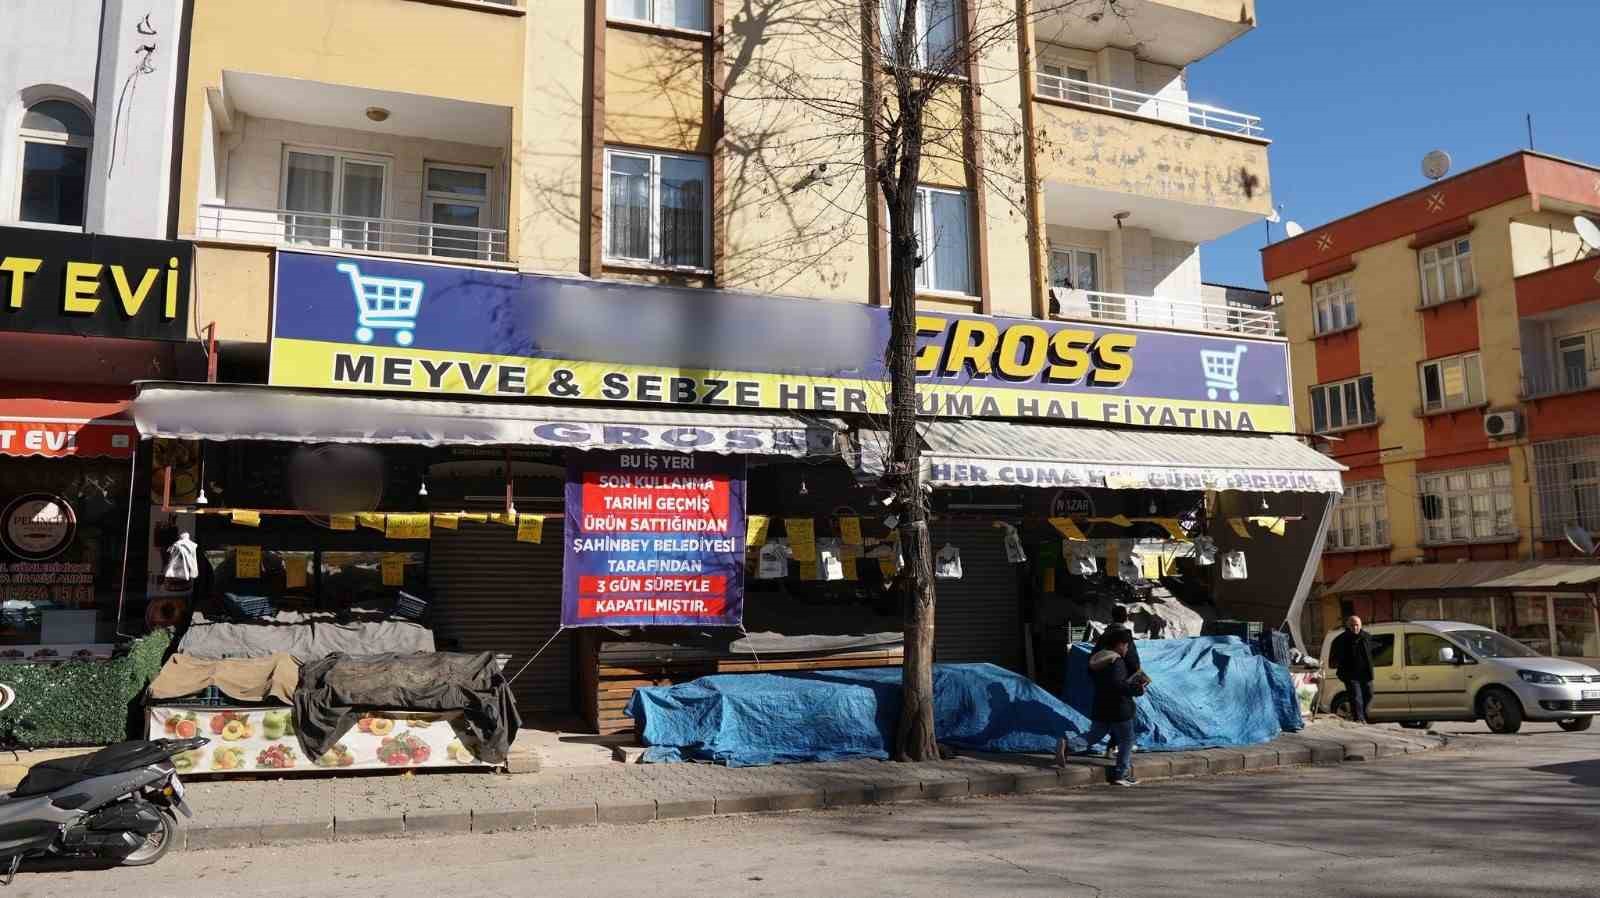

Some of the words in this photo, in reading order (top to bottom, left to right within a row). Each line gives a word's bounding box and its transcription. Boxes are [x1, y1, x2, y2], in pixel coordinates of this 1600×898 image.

[63, 257, 180, 319] EVİ
[333, 353, 526, 394] MEYVE
[547, 368, 582, 397] &
[601, 372, 761, 407] SEBZE
[779, 383, 868, 413] HER
[886, 390, 1001, 418] UMA
[1102, 401, 1255, 432] FİYATINA
[620, 454, 641, 468] BU
[644, 454, 658, 470] İŞ
[662, 454, 695, 469] YERİ
[599, 475, 631, 489] SON
[634, 475, 715, 491] KULLANMA
[930, 463, 988, 483] HER
[999, 466, 1081, 486] CUMA
[603, 493, 653, 510] TARİHİ
[656, 496, 710, 513] GEÇMİŞ
[584, 514, 627, 530] ÜRÜN
[630, 515, 728, 532] SATTIĞINDAN
[573, 534, 649, 553] ŞAHİNBEY
[653, 536, 736, 553] BELEDİYESİ
[607, 559, 702, 572] TARAFINDAN
[596, 580, 606, 593] 3
[609, 576, 641, 592] GÜN
[644, 576, 710, 593] SÜREYLE
[595, 599, 708, 613] KAPATILMIŞTIR.
